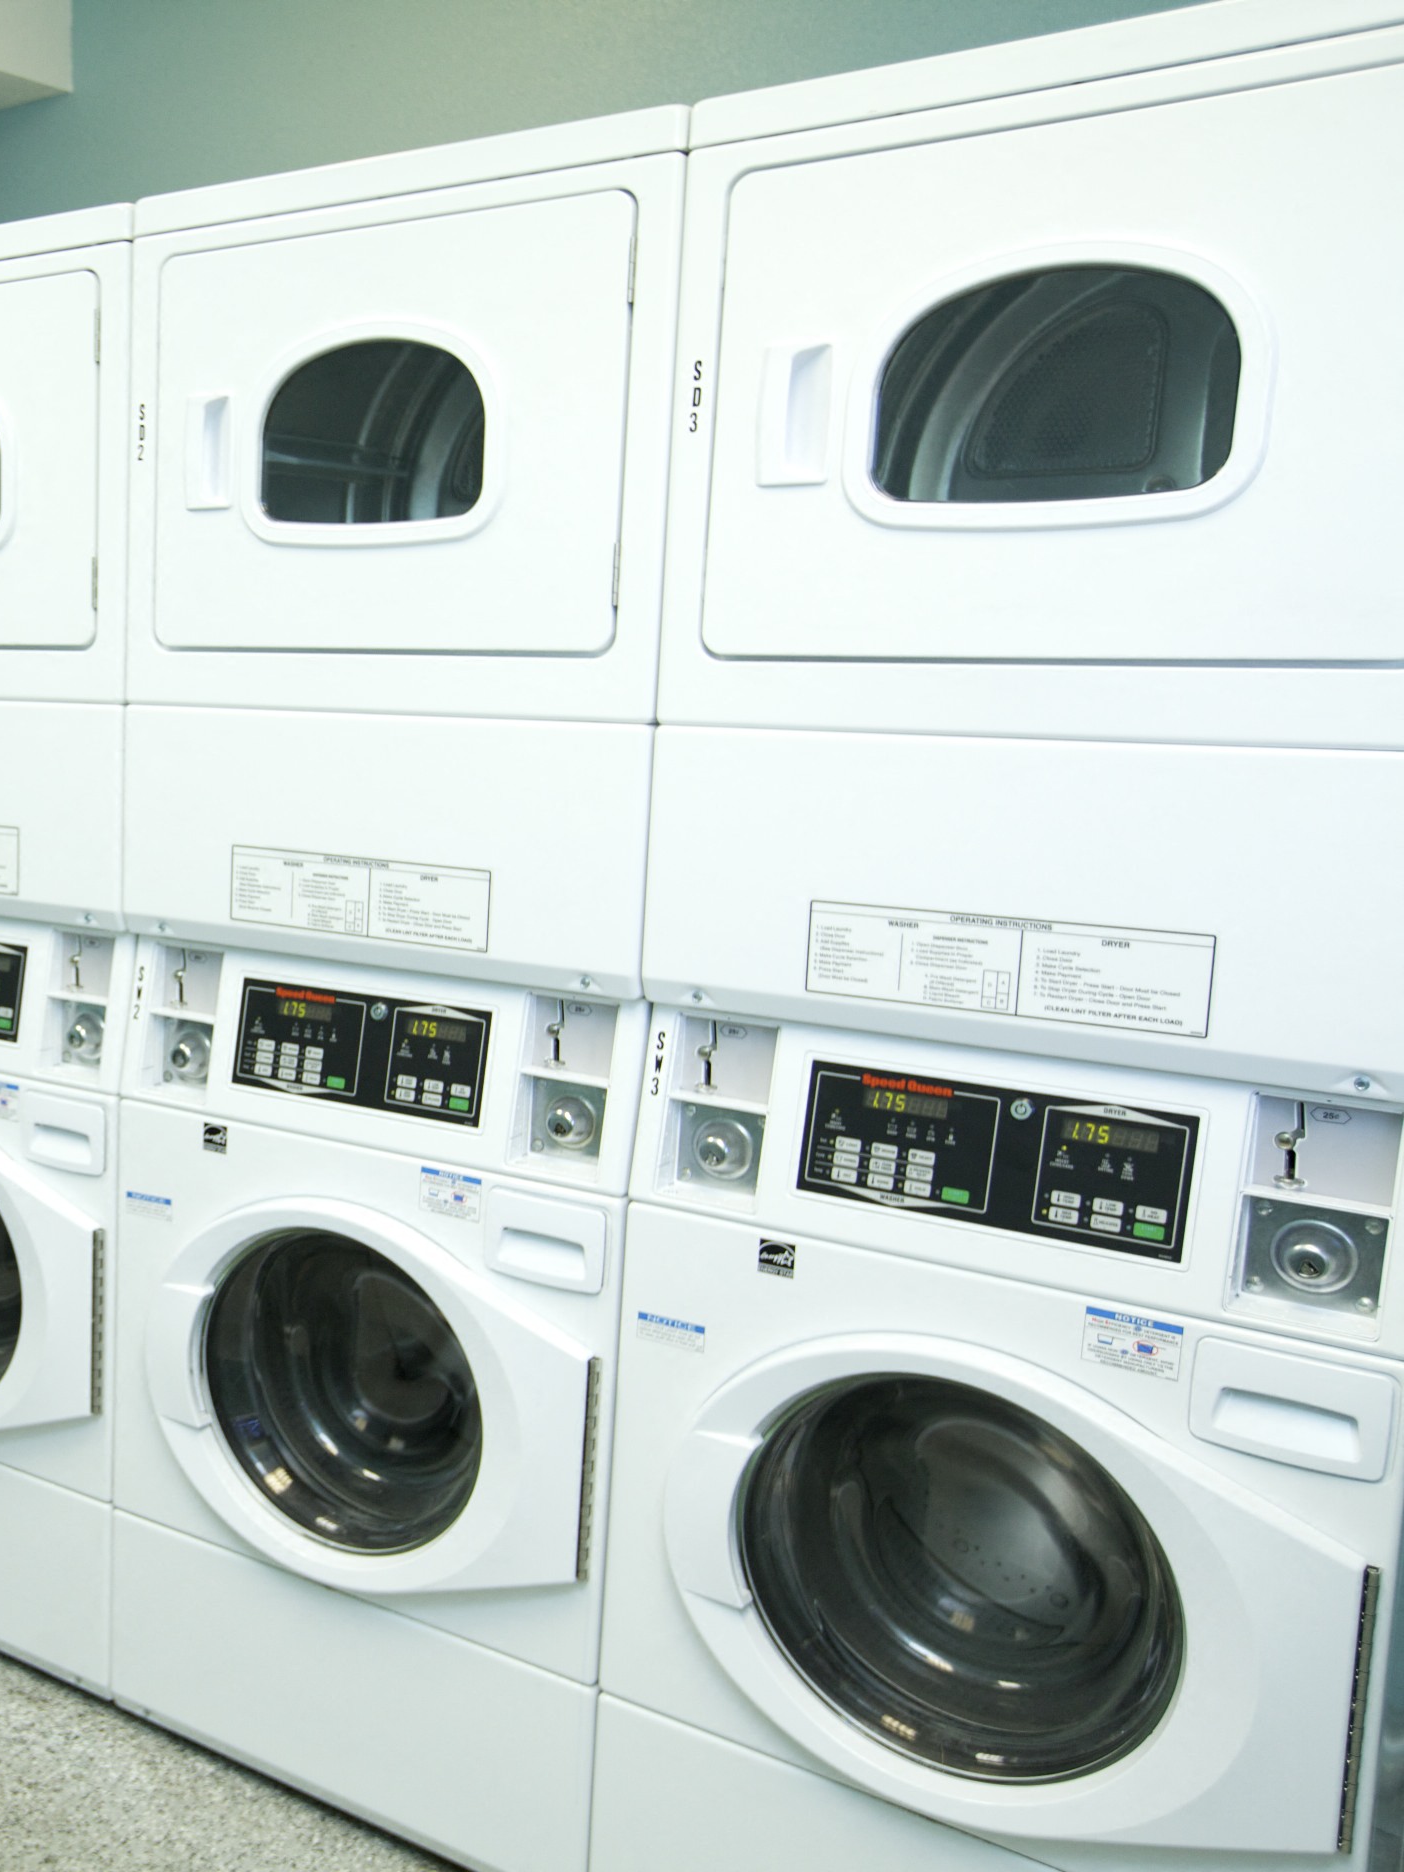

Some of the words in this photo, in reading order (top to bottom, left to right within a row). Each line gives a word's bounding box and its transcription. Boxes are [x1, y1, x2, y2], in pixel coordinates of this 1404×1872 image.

[419, 874, 439, 882] DRYER
[888, 919, 919, 929] WASHER
[949, 915, 993, 926] OPERATING
[995, 918, 1053, 931] INSTRUCTIONS
[1101, 939, 1130, 949] DRYER
[1071, 1006, 1086, 1014] LINT
[1088, 1008, 1112, 1018] FILTER
[1113, 1012, 1137, 1021] AFTER
[1138, 1015, 1158, 1023] EACH
[862, 1073, 906, 1090] Speed
[907, 1079, 953, 1098] Queen
[872, 1091, 907, 1113] 1.75
[1103, 1107, 1127, 1117] DRYER
[1071, 1121, 1110, 1144] 1.75
[879, 1192, 905, 1203] WASHER
[1114, 1312, 1155, 1328] NOTICE
